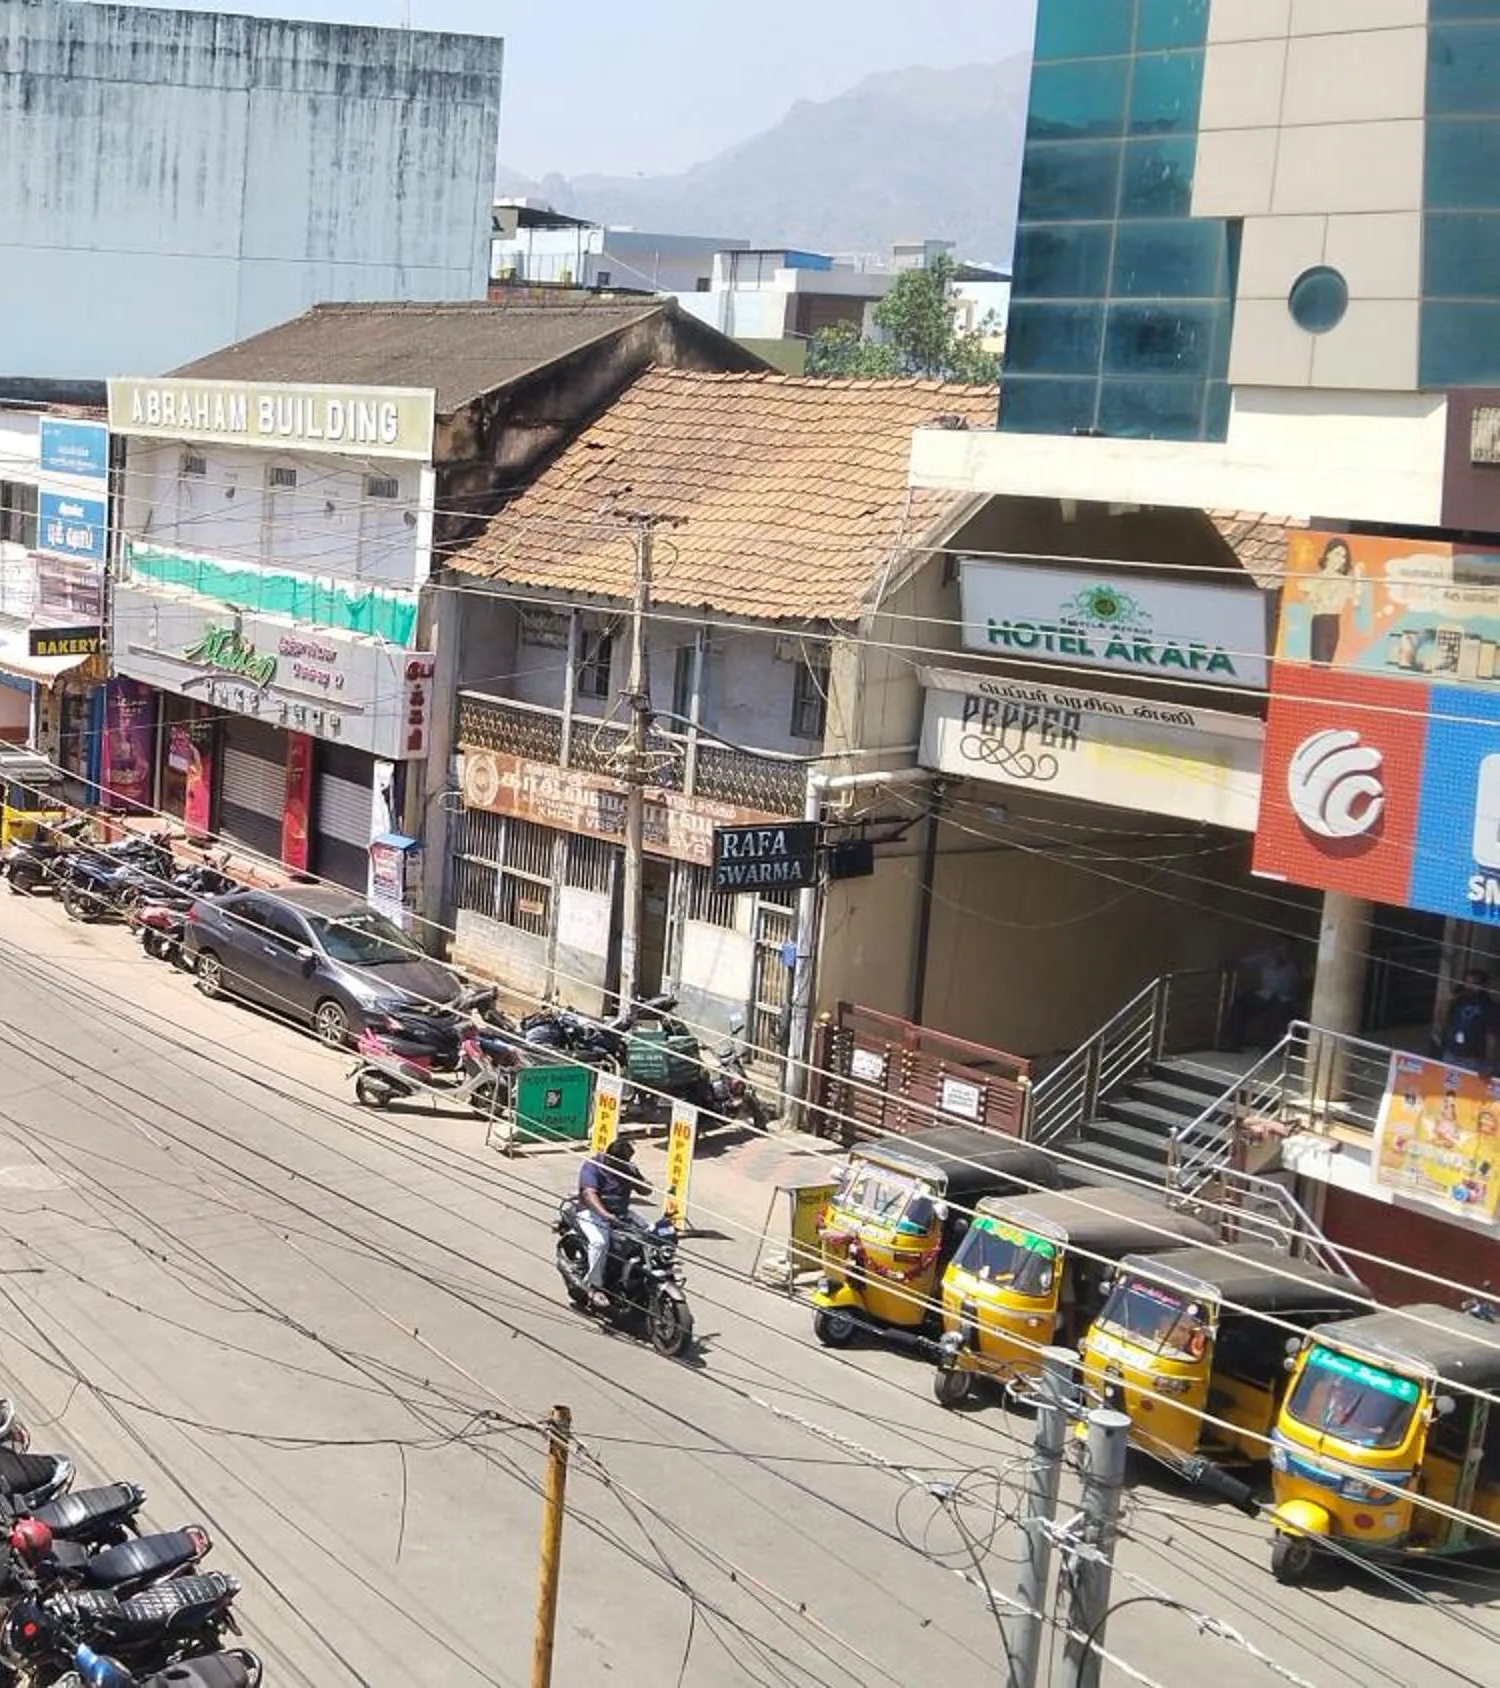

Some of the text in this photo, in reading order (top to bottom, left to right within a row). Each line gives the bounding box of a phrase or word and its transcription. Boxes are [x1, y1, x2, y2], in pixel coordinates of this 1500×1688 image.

[132, 387, 399, 445] ABRAHAM BUILDING
[37, 637, 99, 655] BAKERY
[986, 618, 1095, 658] HOTEL
[1104, 634, 1238, 677] ARAFA
[961, 694, 1082, 752] PEPPER
[720, 830, 789, 859] RAFA
[599, 1092, 618, 1111] NO
[673, 1121, 692, 1140] NO
